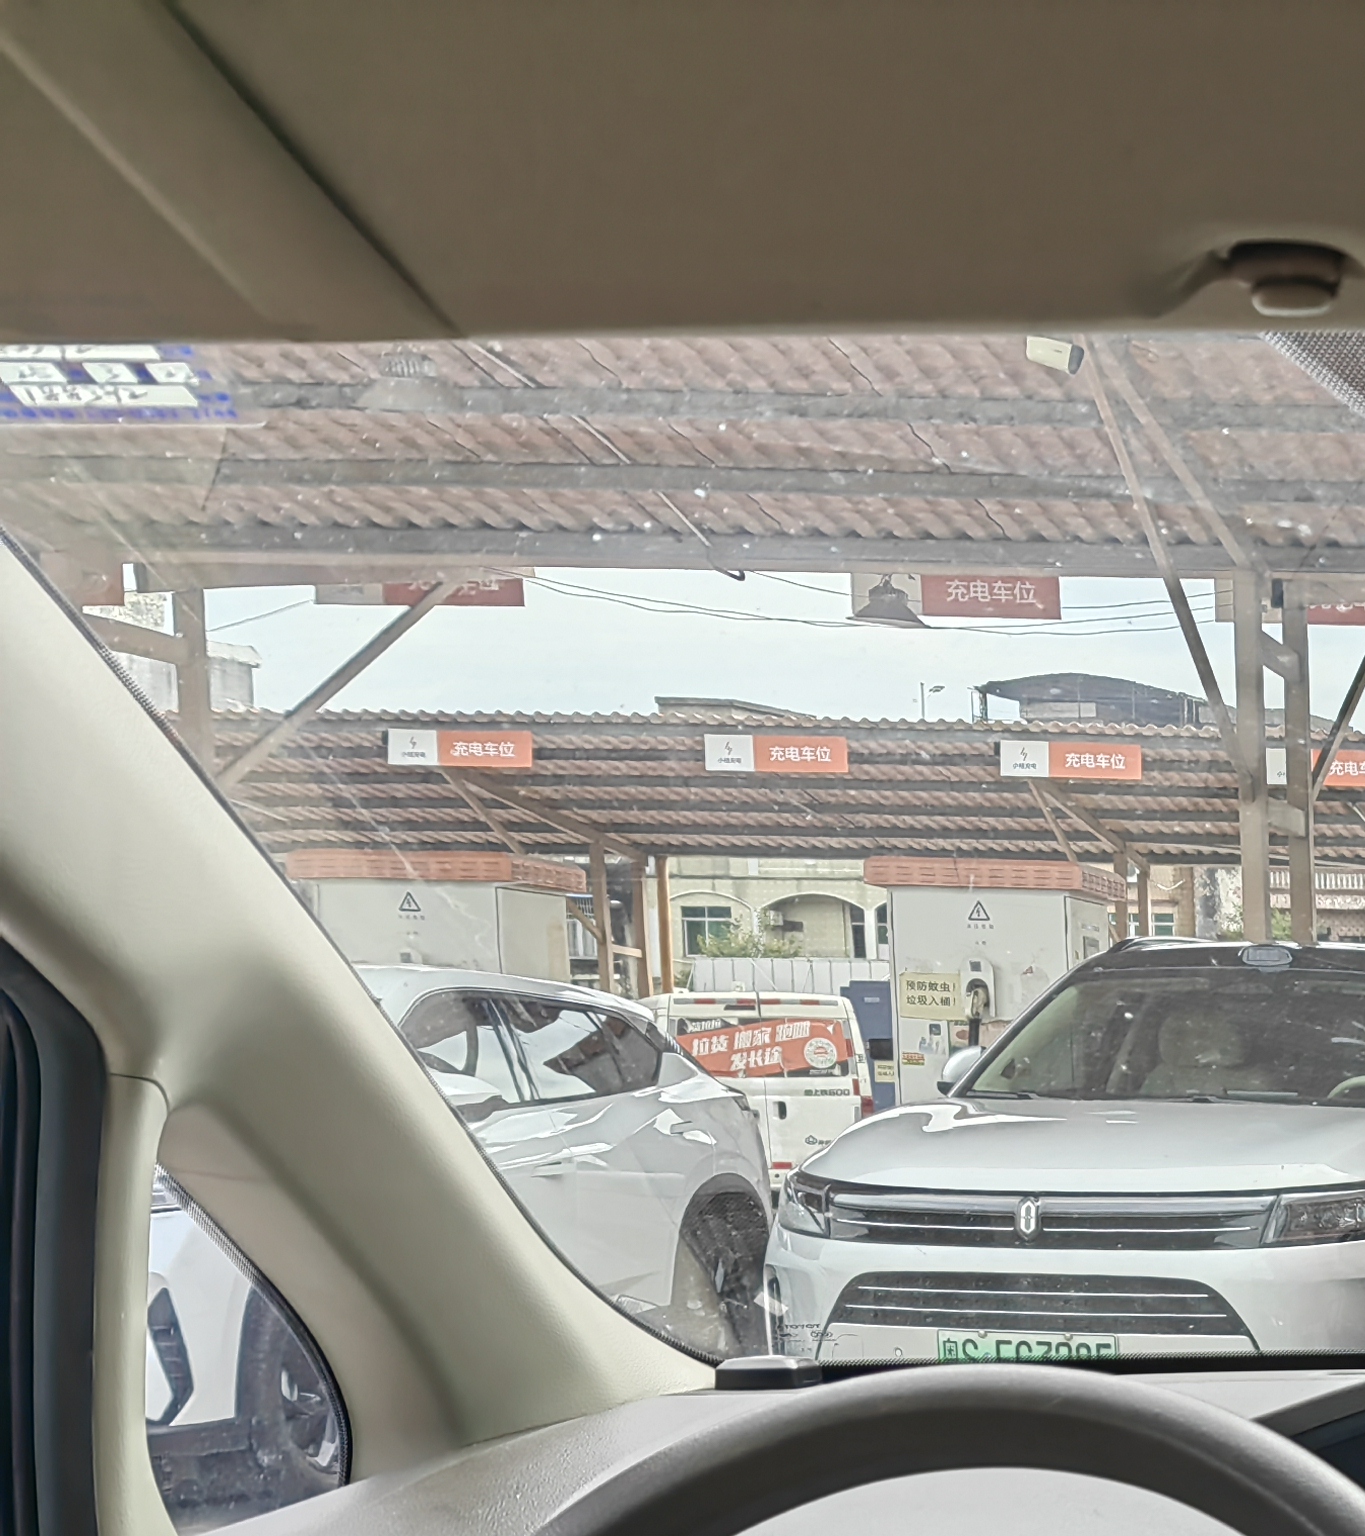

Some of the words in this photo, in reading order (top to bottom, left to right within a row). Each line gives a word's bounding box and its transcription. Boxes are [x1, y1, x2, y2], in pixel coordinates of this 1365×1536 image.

[945, 579, 1037, 604] 充电车位
[449, 741, 516, 758] 充电车位
[769, 745, 832, 762] 充电车位
[1064, 752, 1126, 770] 充电车位
